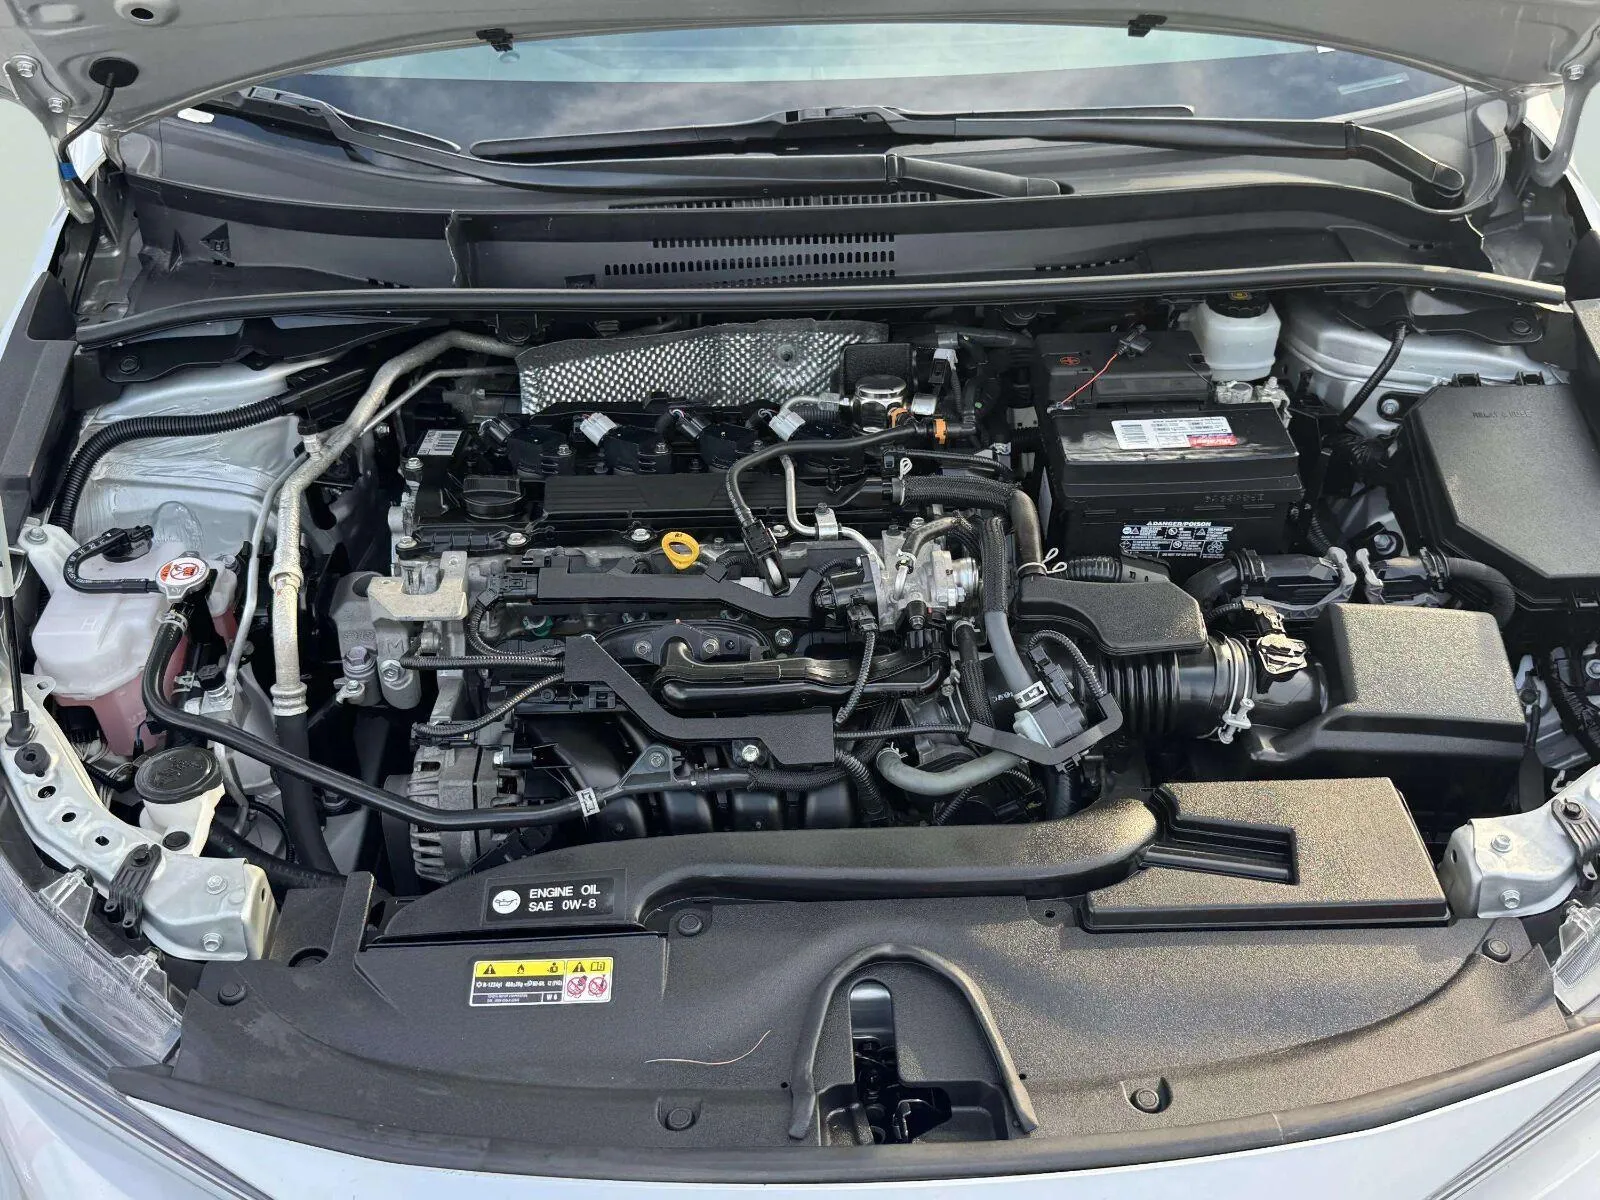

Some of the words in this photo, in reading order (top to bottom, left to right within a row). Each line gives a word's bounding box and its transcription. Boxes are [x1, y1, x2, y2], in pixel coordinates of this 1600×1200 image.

[529, 886, 573, 899] ENGINE
[581, 884, 600, 895] OIL
[528, 900, 553, 912] SAE
[562, 899, 596, 910] 0W-8
